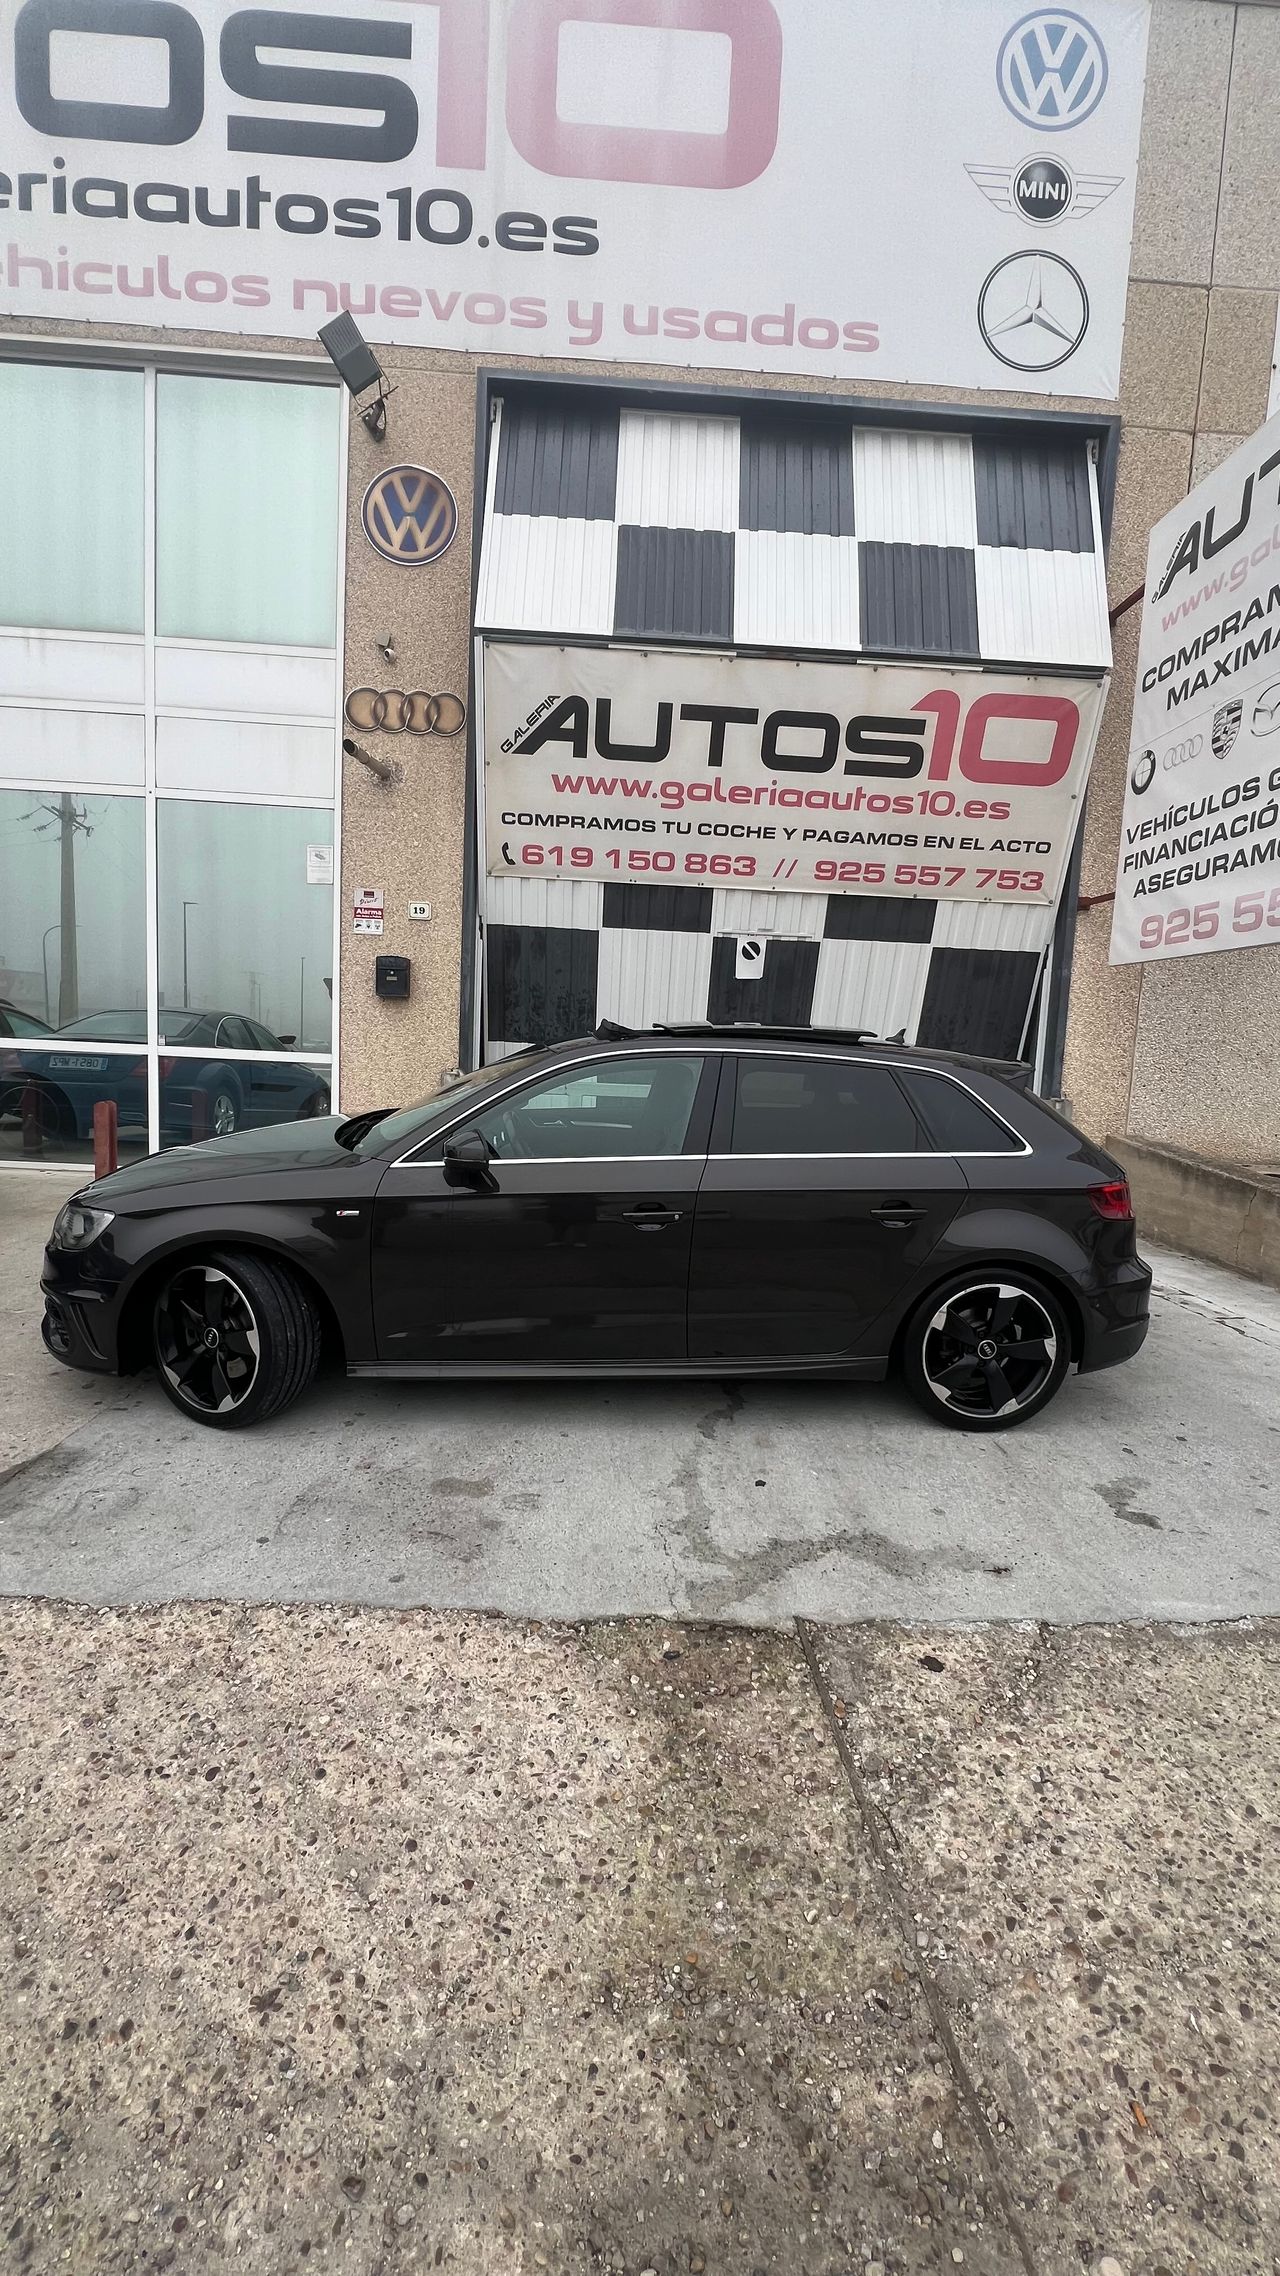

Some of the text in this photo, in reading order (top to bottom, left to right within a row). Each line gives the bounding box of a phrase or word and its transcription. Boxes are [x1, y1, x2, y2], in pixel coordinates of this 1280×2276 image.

[0, 156, 600, 256] riaautos10.es
[1018, 179, 1067, 202] MINI
[0, 243, 880, 353] hiculos nuevos y usados
[501, 695, 561, 753] GALERIA
[511, 689, 1080, 787] AUTOS10
[551, 774, 1011, 820] www.galeriaautos10.es
[1126, 776, 1261, 845] VEHÍCULOS
[501, 812, 1052, 855] COMPRAMOS TU COCHE Y PAGAMOS EN EL ACTO
[1123, 798, 1280, 874] FINANCIACIÓ
[521, 844, 594, 868] 619
[604, 848, 676, 872] 150
[684, 853, 757, 877] 863
[813, 860, 886, 883] 925
[894, 864, 966, 887] 557
[975, 869, 1044, 891] 753
[1133, 838, 1280, 898] ASEGURAM
[355, 908, 382, 916] Alarma
[413, 906, 426, 915] 19
[1139, 901, 1220, 950] 925
